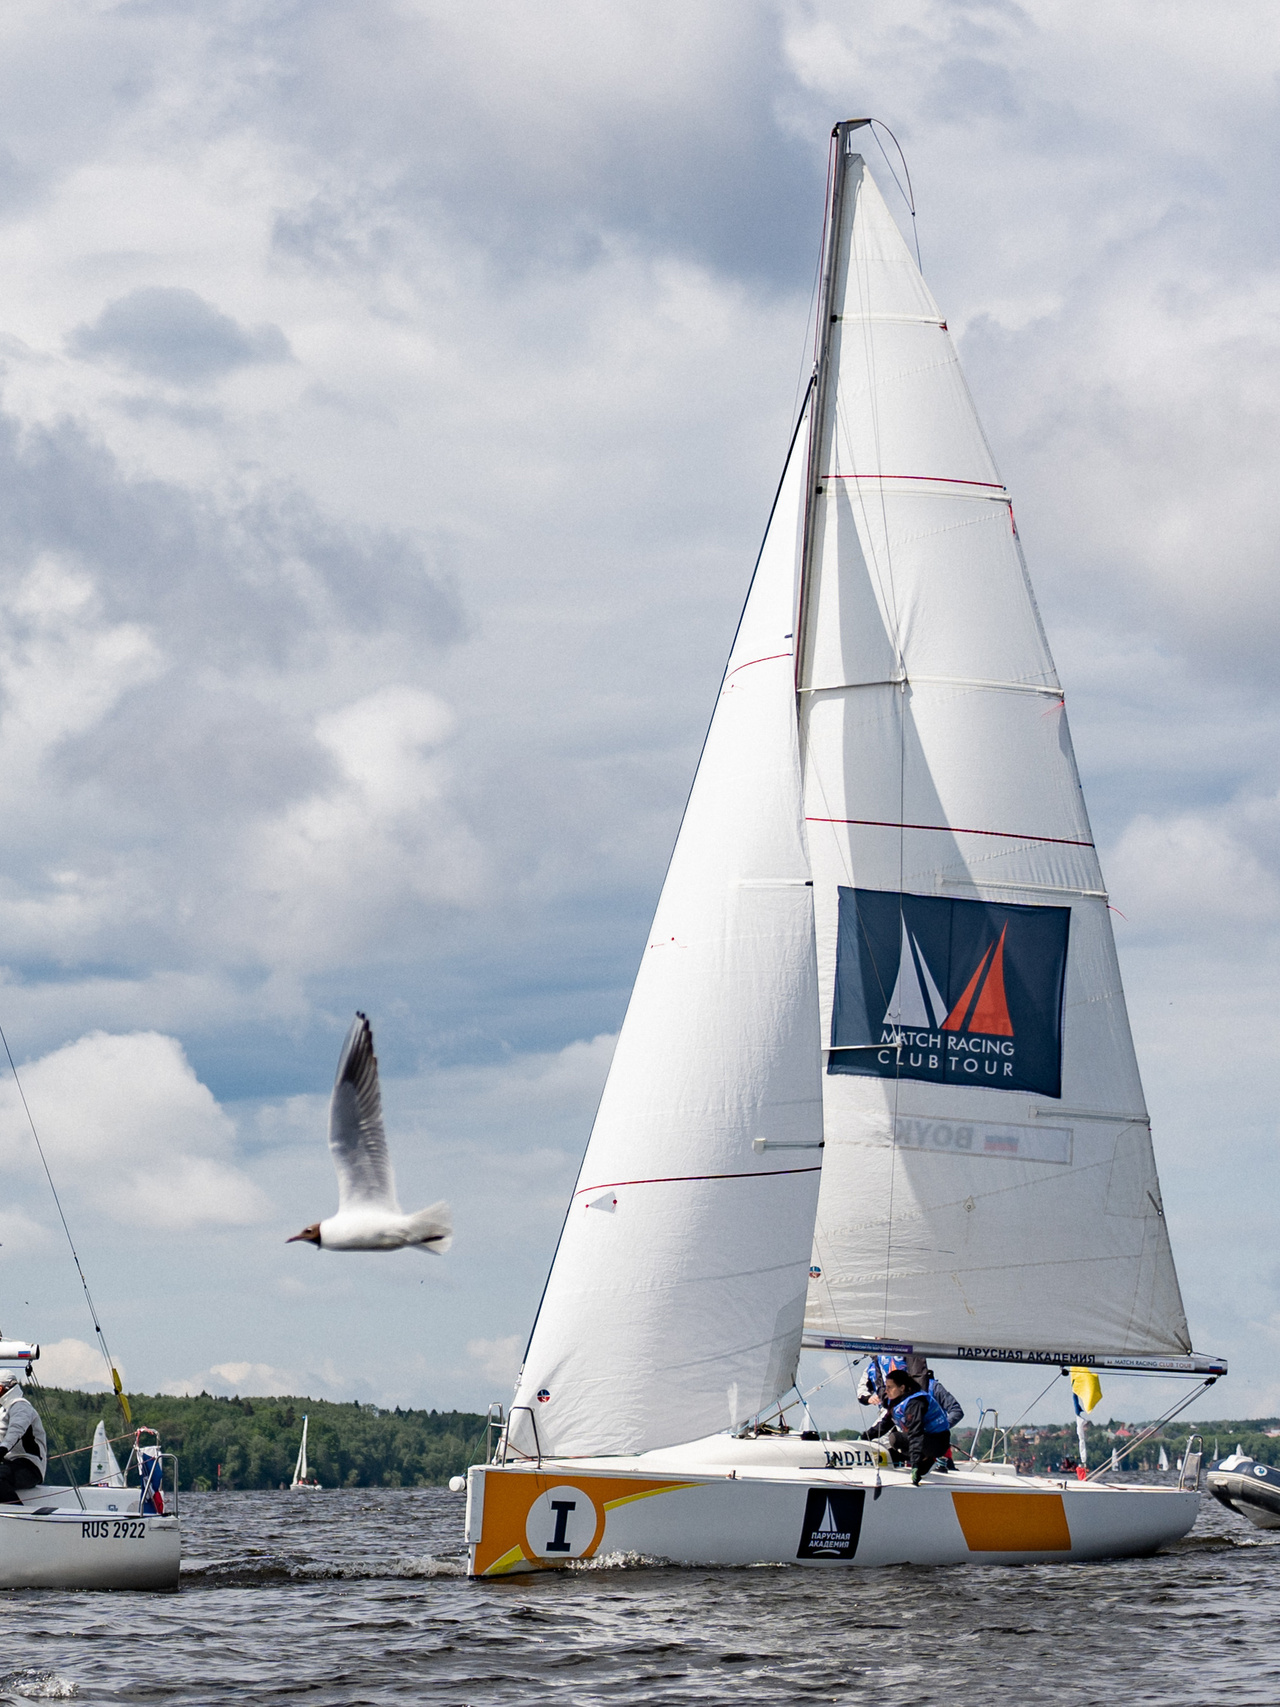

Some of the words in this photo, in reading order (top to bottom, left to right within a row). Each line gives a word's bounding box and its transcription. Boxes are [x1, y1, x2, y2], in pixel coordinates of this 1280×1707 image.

[880, 1030, 941, 1048] MATCH
[947, 1036, 1015, 1056] RACING
[877, 1050, 938, 1068] CLUB
[949, 1057, 1013, 1076] TOUR
[957, 1347, 1023, 1360] ПАРУСНАЯ
[1027, 1351, 1095, 1364] АКАДЕМИЯ
[824, 1451, 874, 1467] INDIA
[82, 1521, 109, 1538] RUS
[113, 1522, 145, 1538] 2922
[546, 1501, 576, 1552] I
[808, 1540, 850, 1549] АКАДЕМИЯ
[811, 1532, 851, 1541] ПАРУСНАЯ
